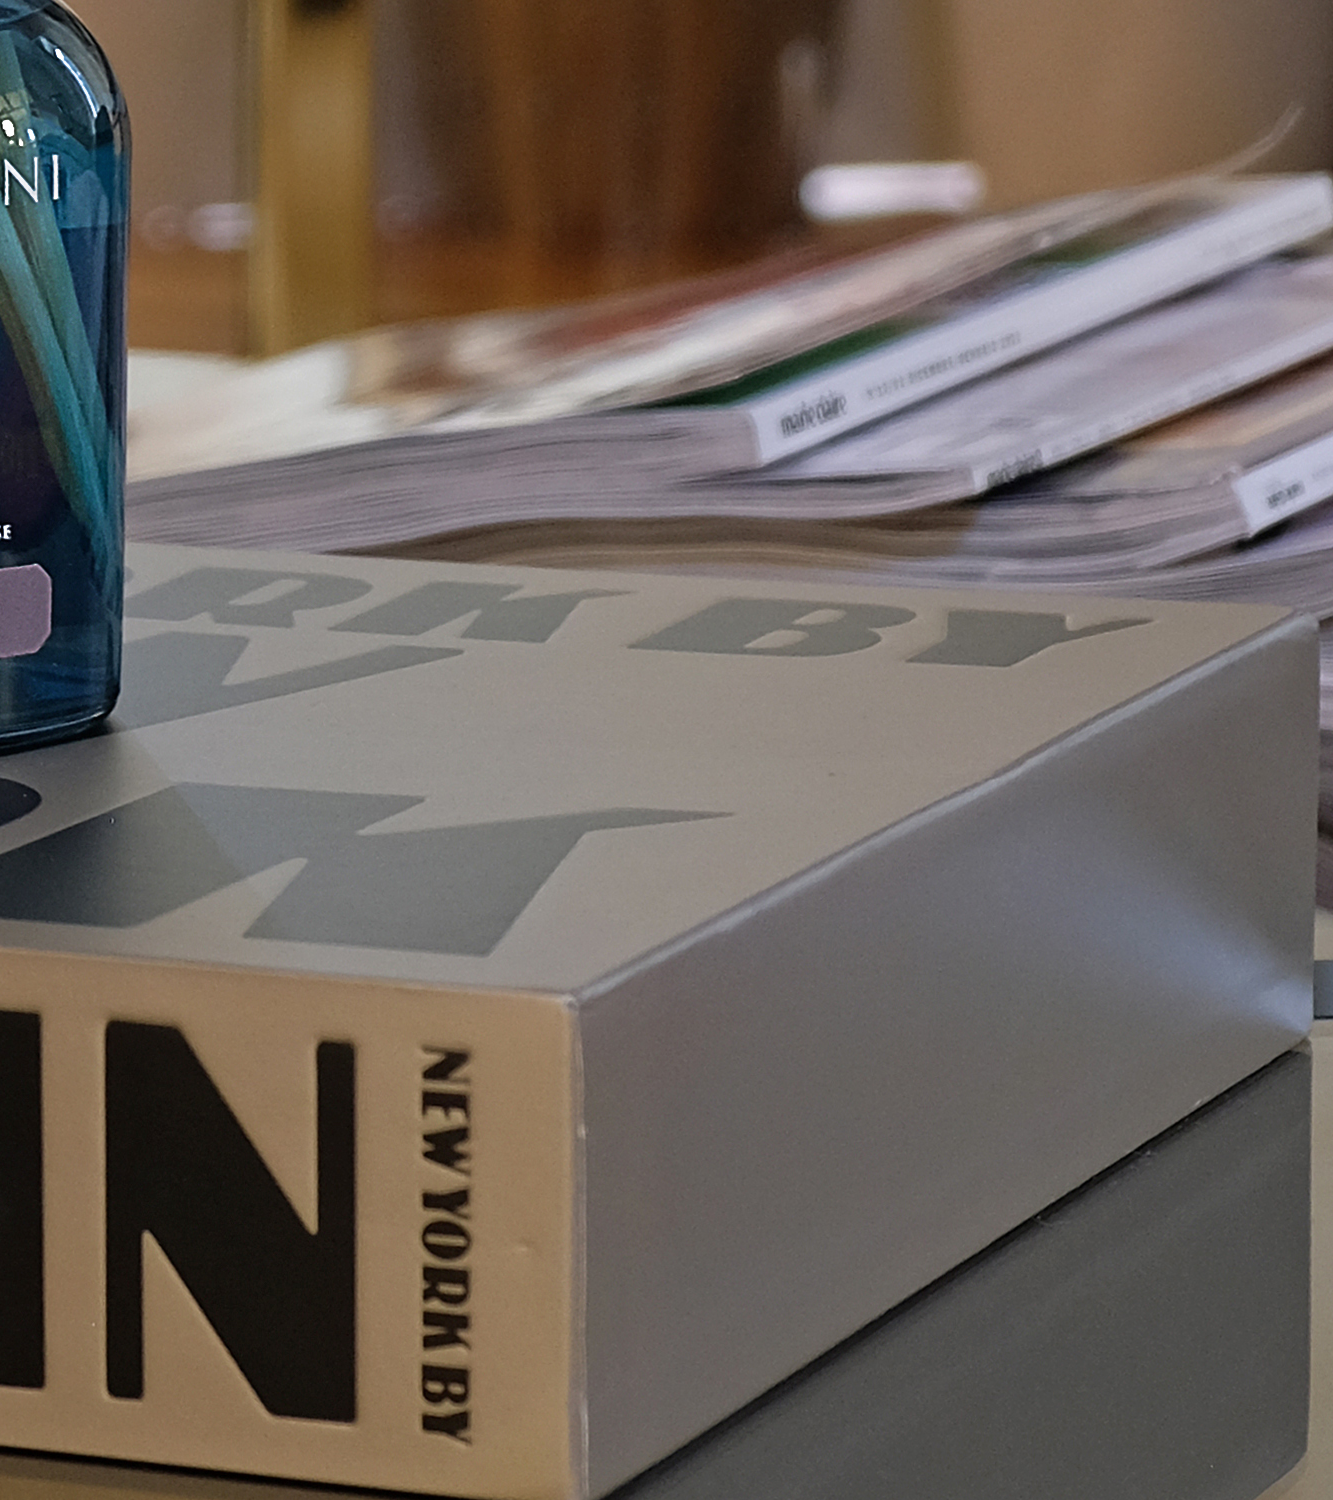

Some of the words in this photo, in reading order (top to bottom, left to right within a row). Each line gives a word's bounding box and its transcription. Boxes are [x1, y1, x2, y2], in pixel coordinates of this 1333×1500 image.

[627, 594, 1154, 669] BY
[420, 1042, 473, 1178] NEW
[420, 1188, 473, 1352] YORK
[420, 1362, 473, 1447] BY
